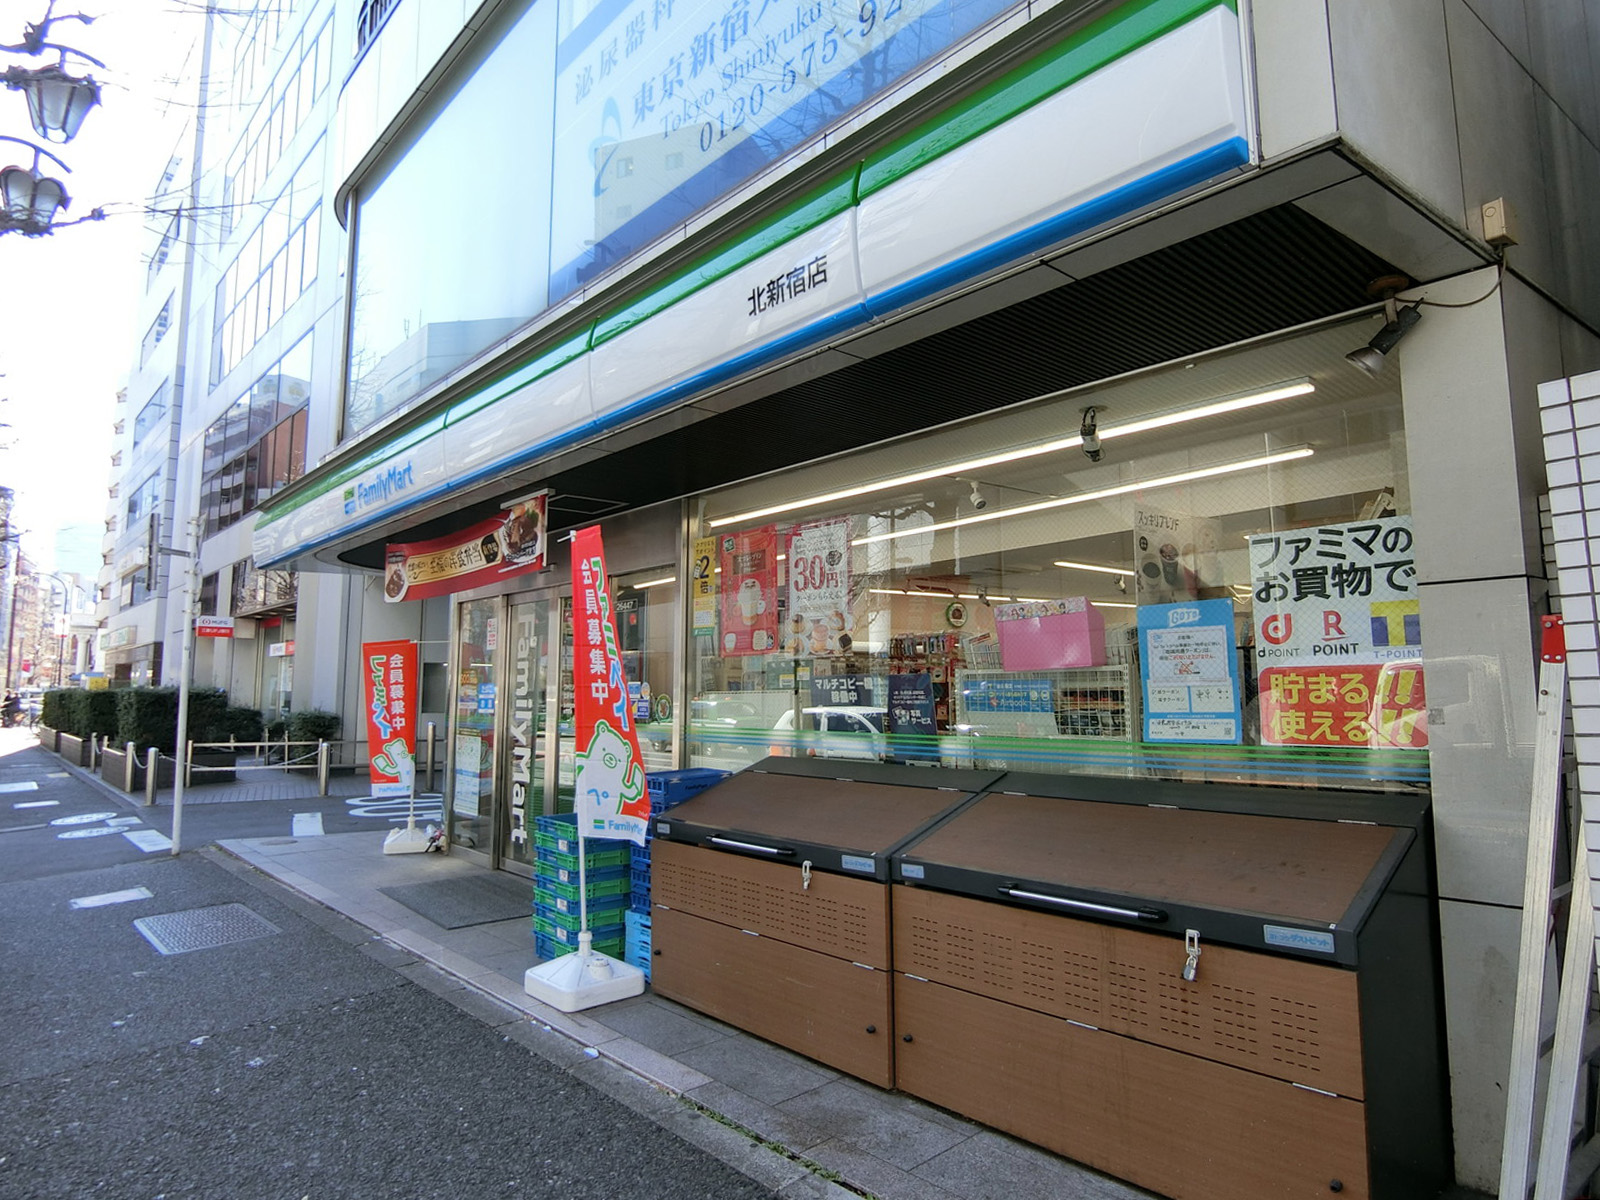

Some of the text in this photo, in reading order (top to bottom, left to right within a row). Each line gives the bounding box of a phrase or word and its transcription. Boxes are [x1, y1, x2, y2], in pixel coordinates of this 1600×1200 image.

[632, 0, 780, 129] 東京新宿
[660, 88, 715, 139] Tokyo
[747, 254, 828, 316] 北新宿店
[357, 459, 414, 509] FamilyMart
[1251, 523, 1414, 569] ファミマの
[1255, 558, 1418, 603] お買物で
[581, 558, 609, 706] 会員募集中
[1268, 647, 1300, 658] POINT
[1313, 642, 1360, 657] POINT
[1374, 649, 1422, 659] T-POINT
[510, 613, 535, 844] FamilyMart
